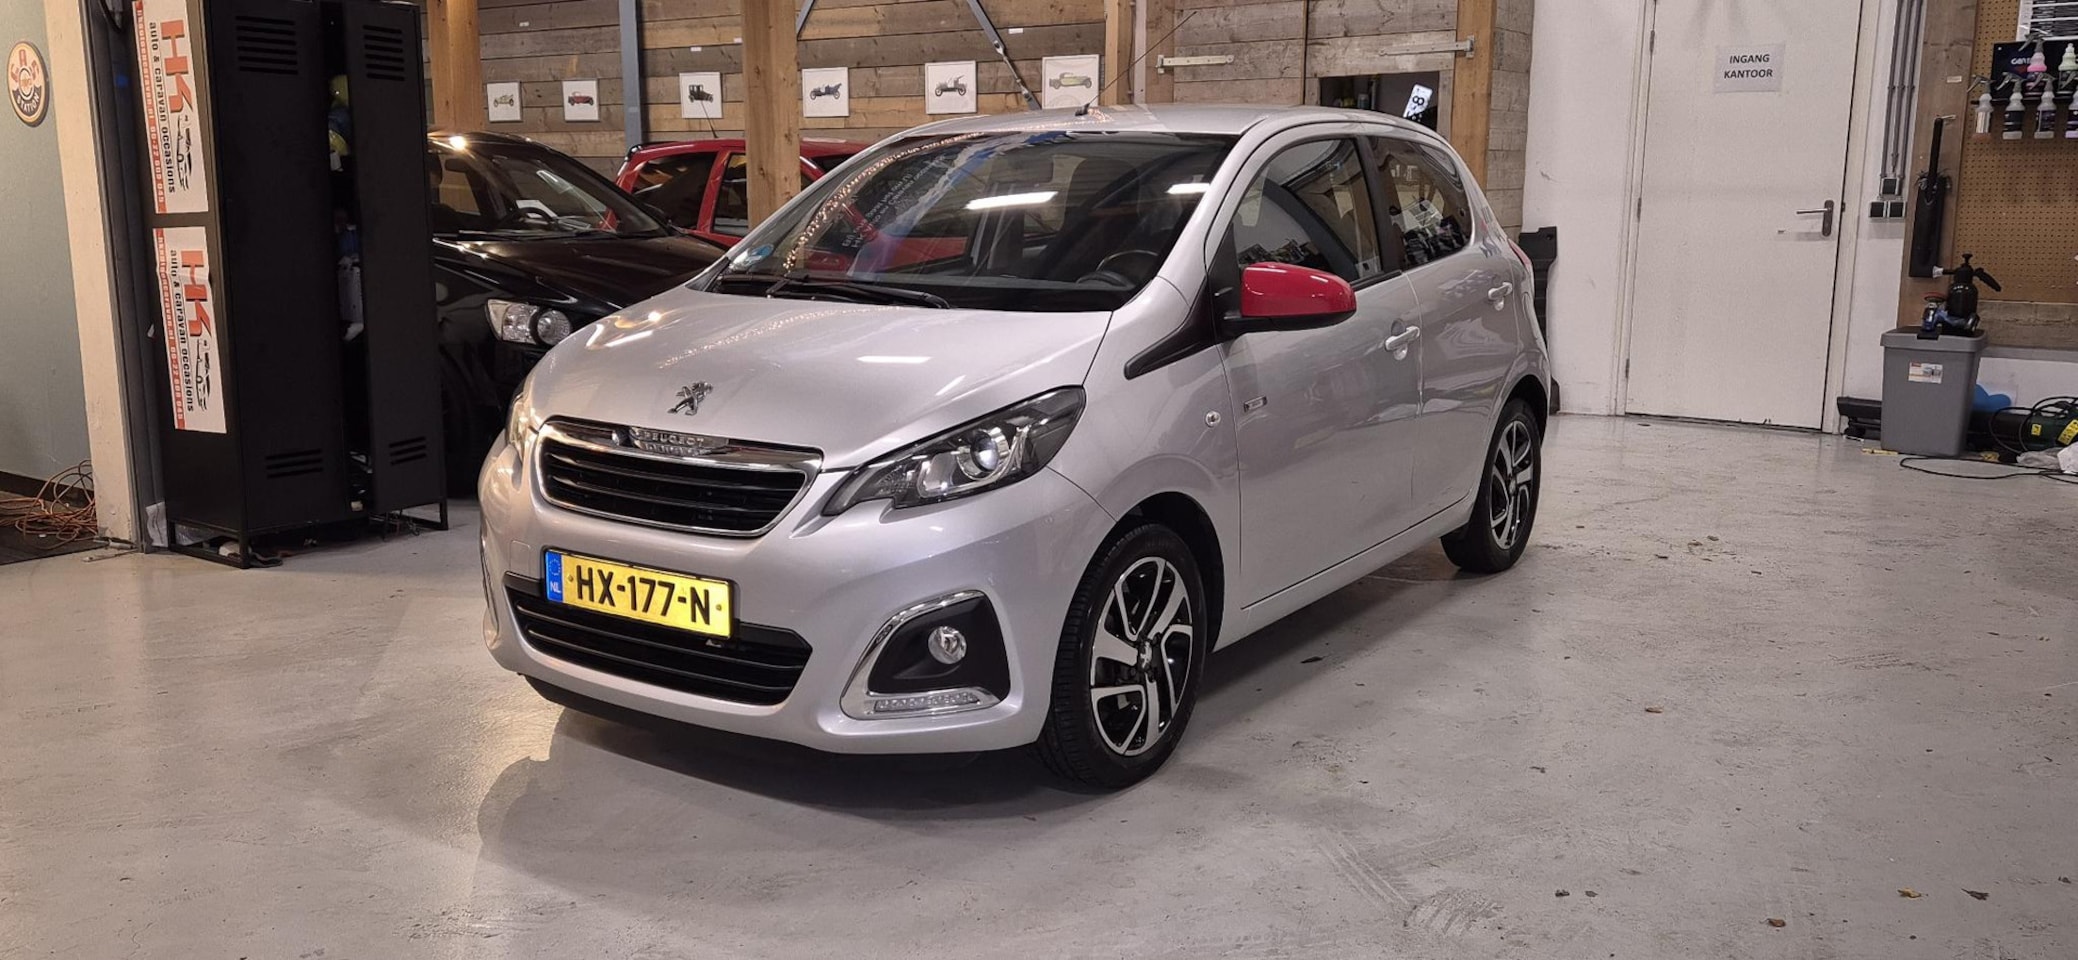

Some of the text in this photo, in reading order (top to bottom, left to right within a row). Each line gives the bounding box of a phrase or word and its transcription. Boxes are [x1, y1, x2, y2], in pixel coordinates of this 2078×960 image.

[160, 20, 194, 113] HK
[1724, 69, 1773, 79] KANTOOR
[1729, 54, 1770, 64] INGANG
[16, 93, 40, 113] STATION
[149, 22, 159, 51] auto
[154, 68, 167, 122] caravan
[161, 127, 175, 193] occasions
[170, 250, 179, 277] auto
[180, 250, 212, 337] HK
[174, 293, 187, 344] caravan
[181, 348, 194, 412] occasions
[643, 431, 704, 446] PEUGEOT
[550, 581, 561, 594] NL
[576, 565, 710, 625] HX-177-N
